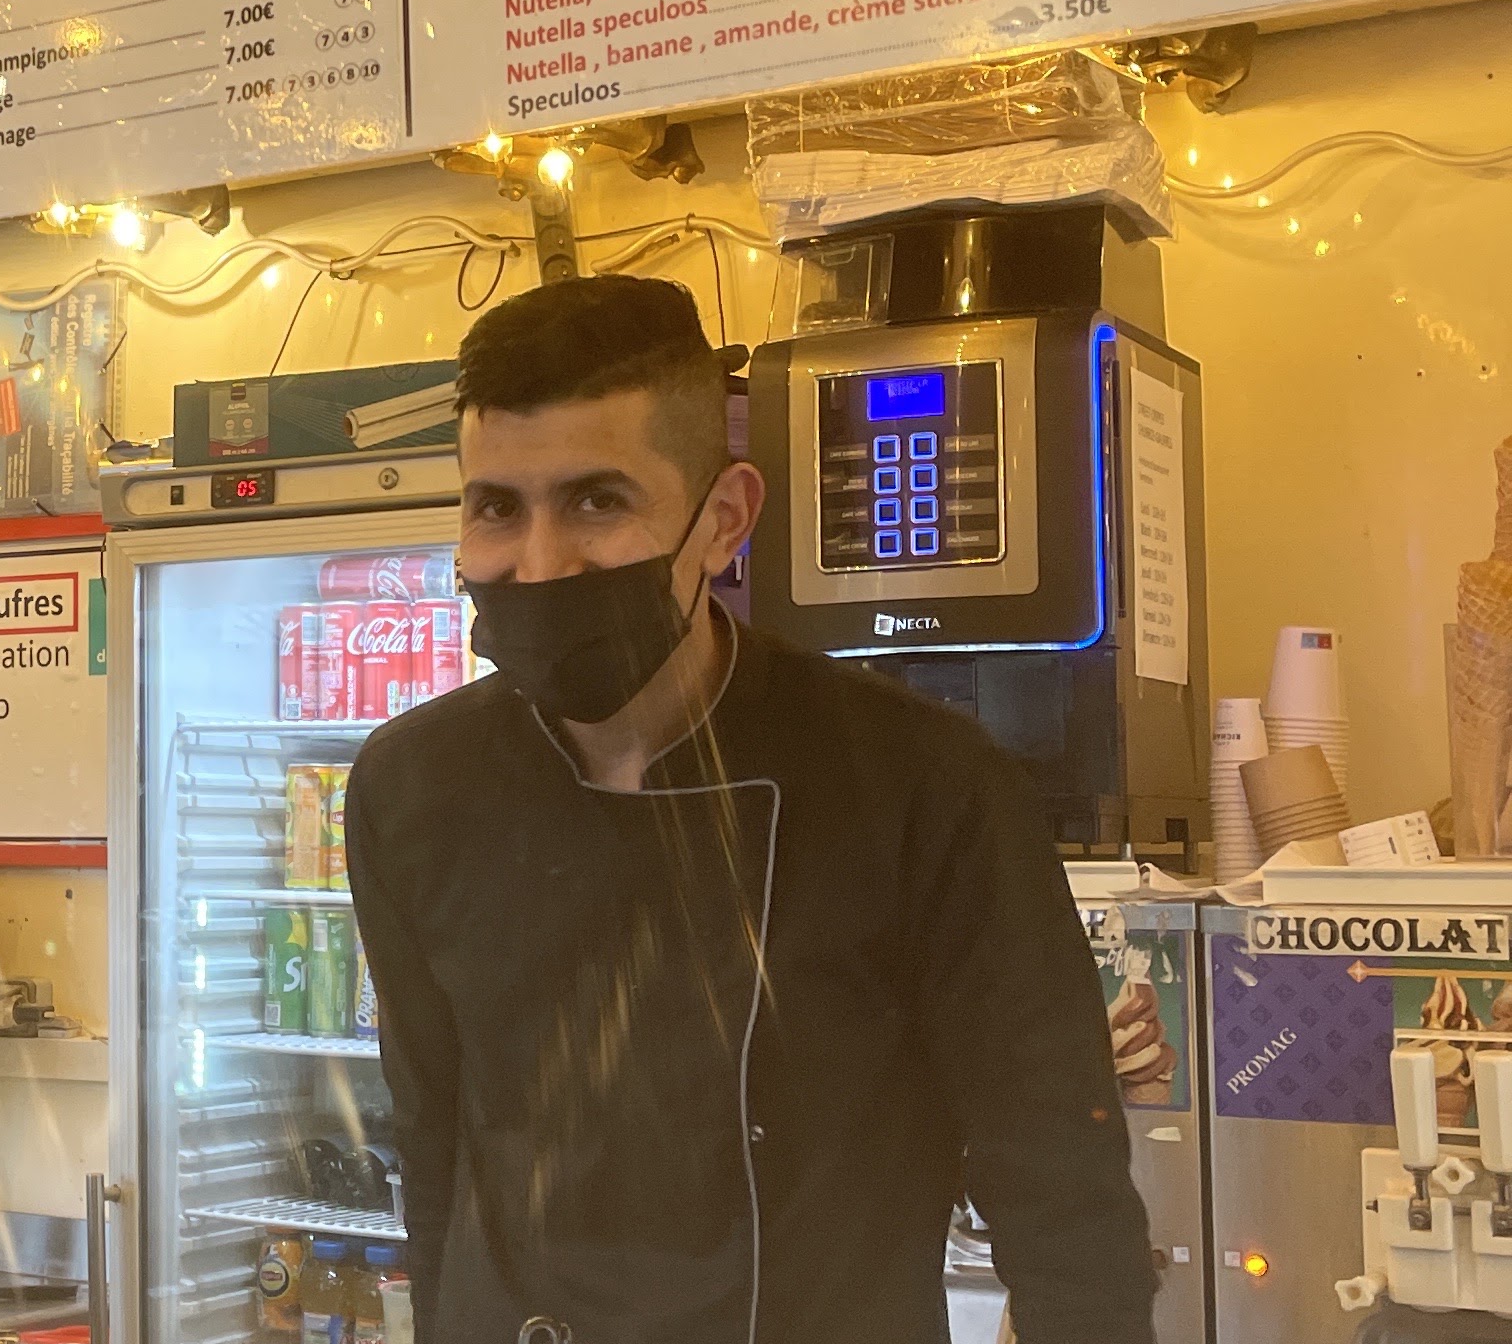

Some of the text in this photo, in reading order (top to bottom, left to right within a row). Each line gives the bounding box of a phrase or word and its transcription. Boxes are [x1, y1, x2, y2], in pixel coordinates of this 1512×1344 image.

[505, 14, 587, 54] Nutella
[896, 616, 941, 631] NECTA
[1251, 916, 1503, 954] CHOCOLAT
[1226, 1026, 1298, 1095] PROMAG
